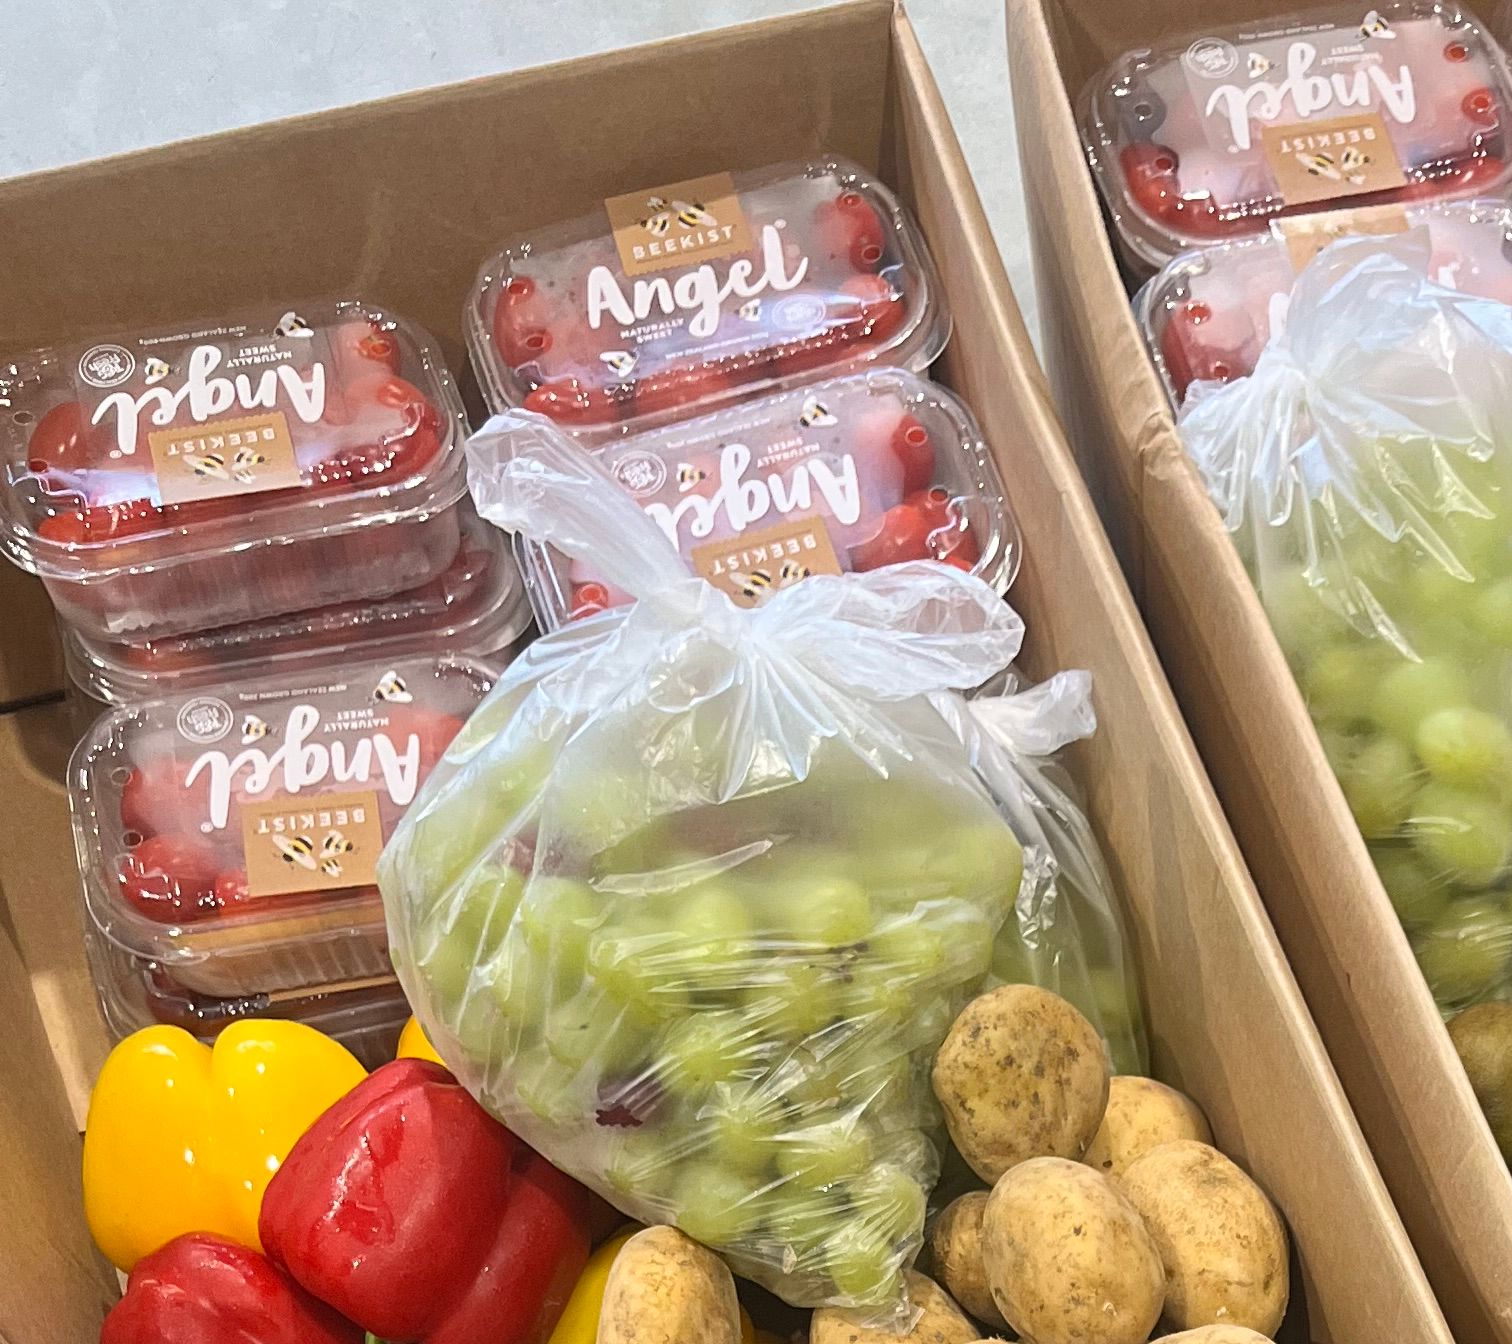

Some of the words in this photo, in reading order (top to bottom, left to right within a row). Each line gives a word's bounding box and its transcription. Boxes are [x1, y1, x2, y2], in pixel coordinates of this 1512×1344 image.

[1205, 43, 1414, 149] Angel
[1278, 128, 1375, 152] BEEKIST
[632, 226, 734, 259] BEEKIST
[587, 226, 808, 337] Angel
[226, 350, 291, 367] NATURALLY
[238, 344, 276, 356] SWEET
[91, 346, 323, 457] Angel
[167, 430, 275, 459] BEEKIST
[711, 534, 816, 575] BEEKIST
[323, 716, 388, 731] NATURALLY
[336, 708, 373, 719] SWEET
[185, 705, 418, 828] Angel
[257, 809, 364, 833] BEEKIST
